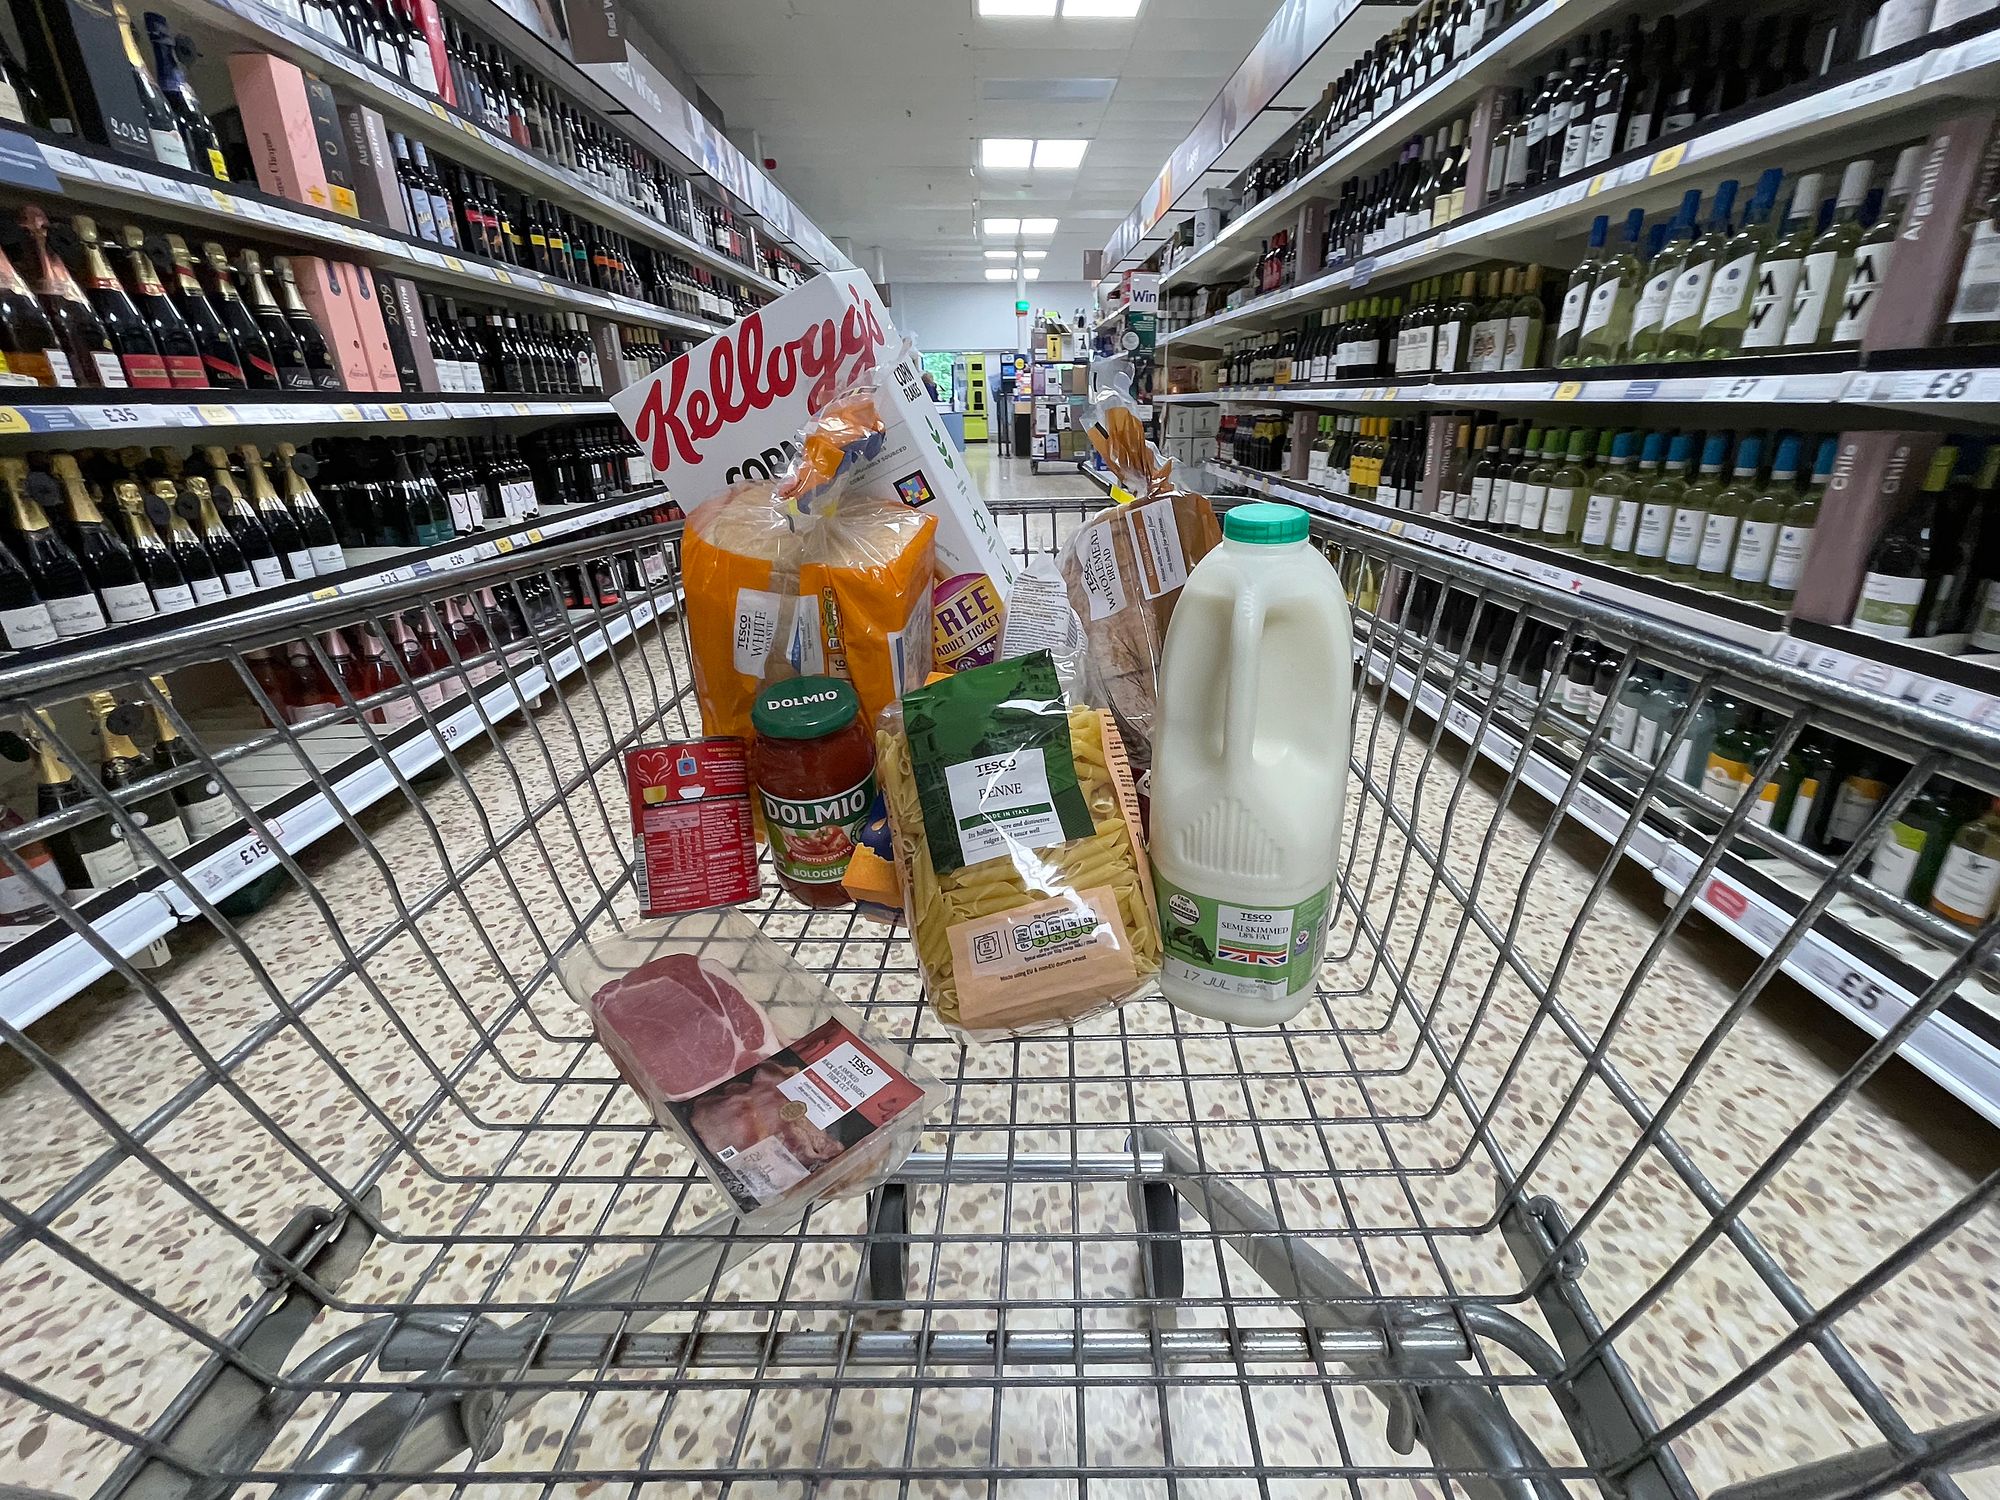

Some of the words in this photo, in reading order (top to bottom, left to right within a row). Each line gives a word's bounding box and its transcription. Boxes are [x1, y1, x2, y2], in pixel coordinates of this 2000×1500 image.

[350, 112, 371, 167] Australia
[367, 115, 385, 169] Australia
[1902, 135, 1950, 241] Argentina
[1132, 290, 1157, 303] Win
[635, 284, 885, 471] Kellogg's
[1924, 372, 1973, 399] £8
[1728, 379, 1760, 398] £7
[103, 408, 139, 423] £35
[450, 552, 466, 567] £26
[1091, 529, 1116, 610] WHOLEMEAL
[1102, 548, 1116, 582] BREAD
[1083, 563, 1099, 594] TESC
[936, 585, 995, 637] REE
[737, 614, 748, 649] TESCO
[751, 610, 767, 658] WHITE
[935, 636, 966, 668] ADULT
[965, 613, 1000, 642] TICKET
[836, 659, 846, 671] 16
[767, 690, 838, 710] DOLMIO
[442, 726, 457, 745] £19
[975, 759, 1016, 772] TESCO
[978, 783, 1023, 800] PENNE
[765, 789, 866, 825] DOLMIO
[1012, 808, 1030, 817] ITALY
[976, 827, 995, 836] hollow
[1023, 815, 1050, 825] distinctive
[983, 836, 1000, 845] ridges
[240, 842, 269, 867] £15
[791, 850, 822, 863] SMOOTH
[824, 845, 852, 862] TOMATO
[793, 865, 847, 878] BOLOGNE
[1171, 900, 1198, 916] FARMERS
[1177, 894, 1191, 905] FAIR
[1240, 912, 1273, 921] TESCO
[1221, 921, 1245, 932] SEMI
[1244, 925, 1289, 934] SKIMMED
[1014, 970, 1027, 980] using
[1072, 955, 1086, 964] wheat
[1184, 969, 1201, 982] 17
[1203, 977, 1232, 991] JUL
[1837, 972, 1883, 1010] £5
[853, 1055, 874, 1076] TESCO
[846, 1079, 866, 1099] RASHERS
